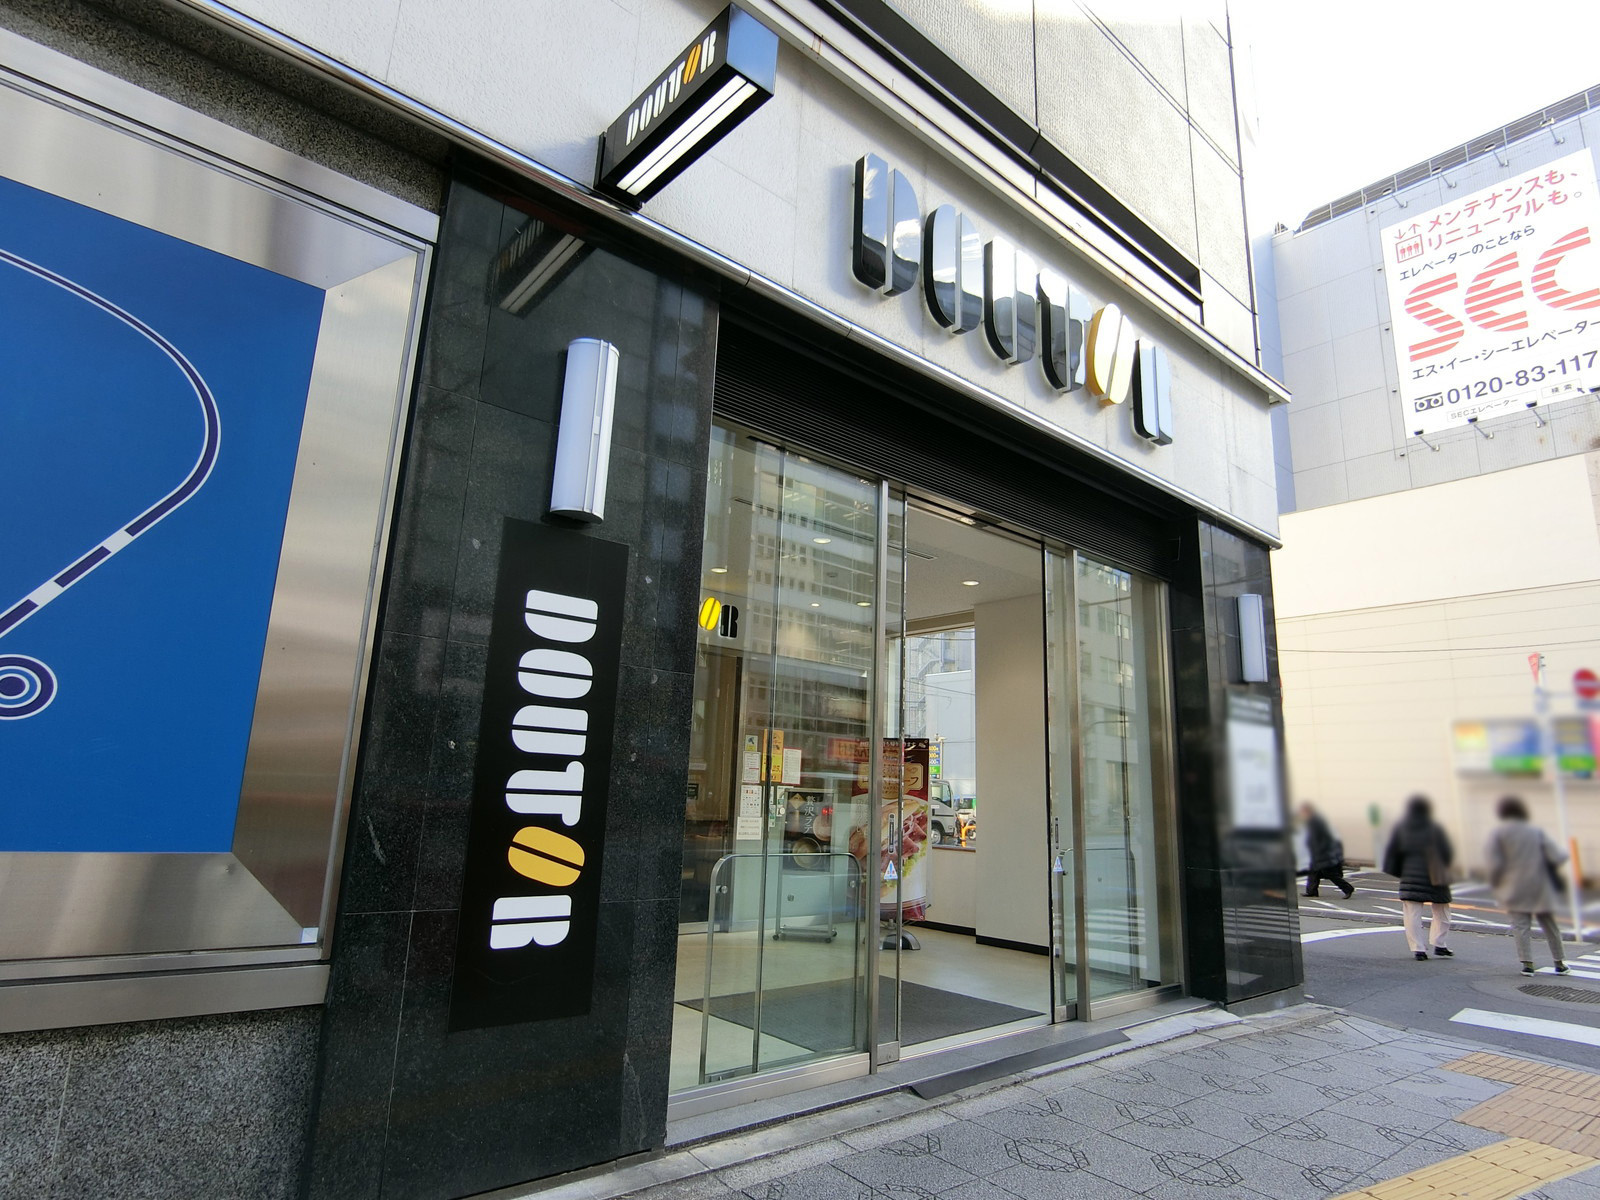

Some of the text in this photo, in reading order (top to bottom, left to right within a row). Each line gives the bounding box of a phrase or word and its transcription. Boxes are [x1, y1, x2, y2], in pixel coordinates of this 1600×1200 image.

[626, 30, 716, 146] DOUTOR
[1428, 169, 1578, 233] メンテナンスも、
[1428, 190, 1583, 250] リニューアルも。
[1400, 225, 1536, 281] エレベーターのことなら
[852, 152, 1172, 447] DOUTOR
[1404, 226, 1600, 362] SEC
[1447, 350, 1598, 404] 0120-83-117
[1451, 399, 1518, 420] SECエレベーター
[490, 589, 598, 950] DOUTOR
